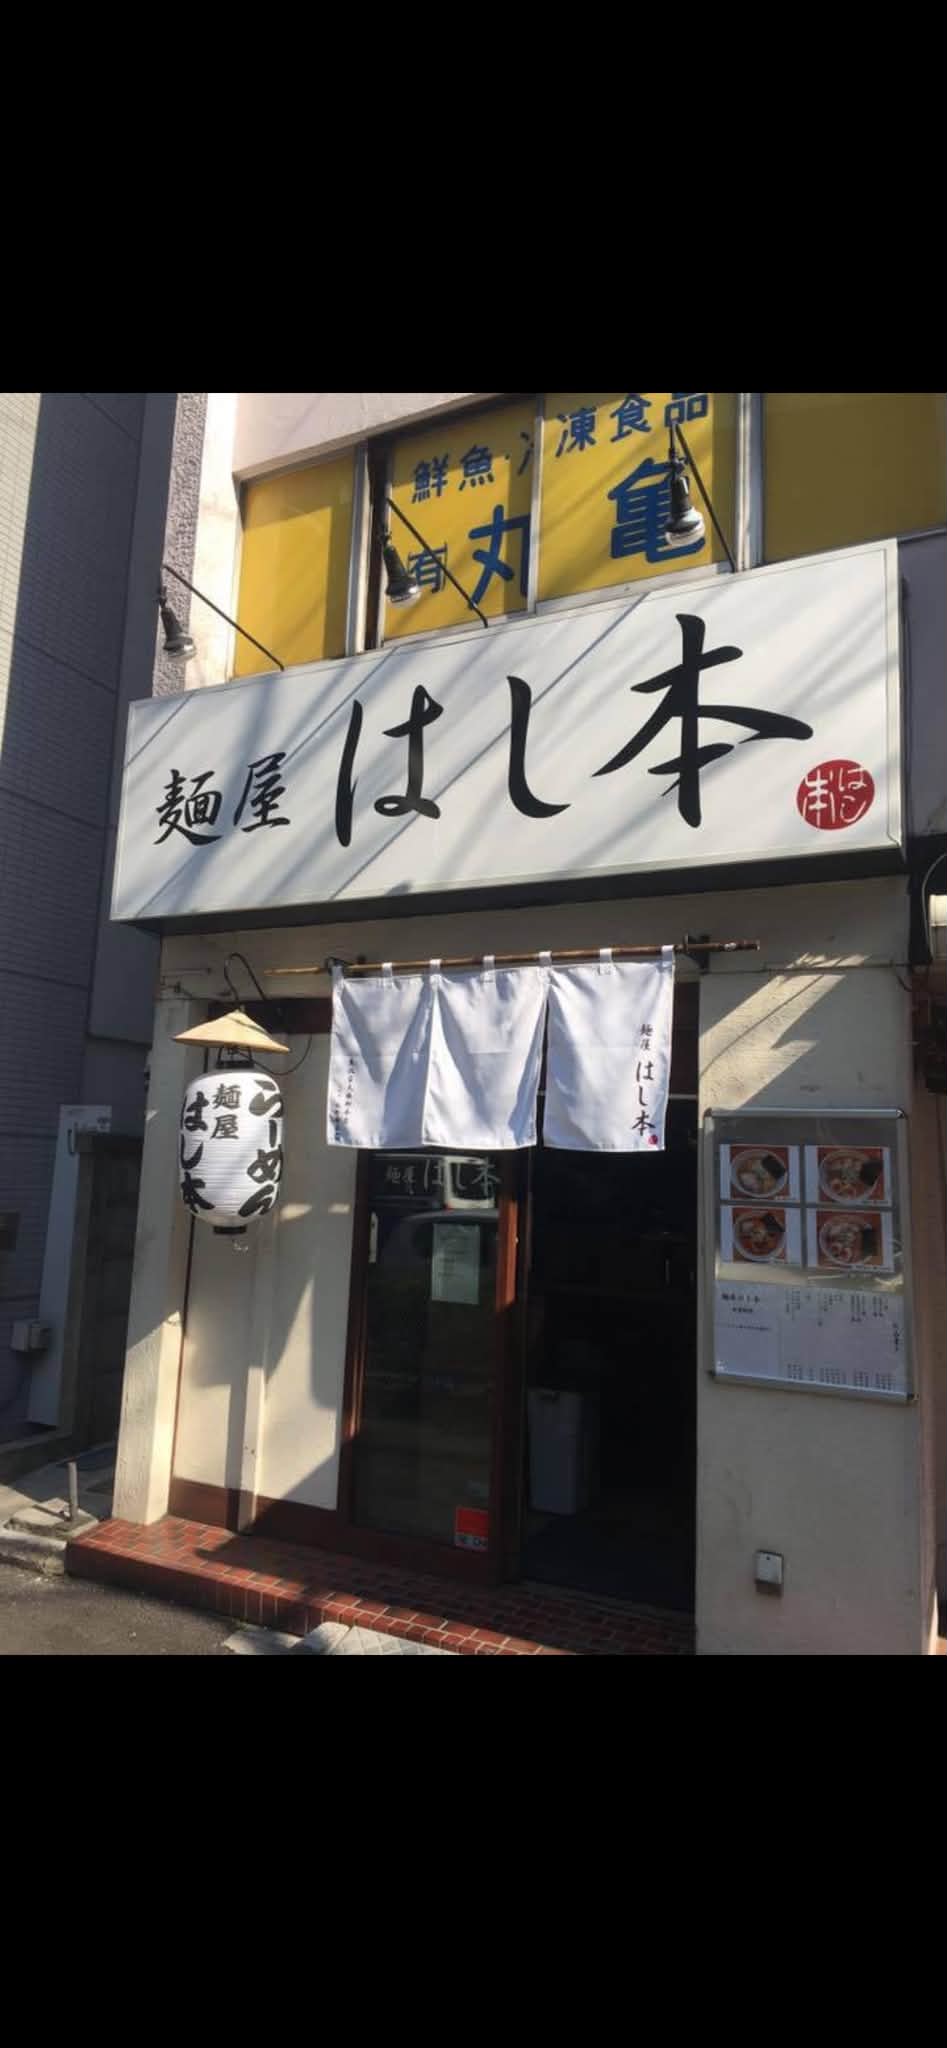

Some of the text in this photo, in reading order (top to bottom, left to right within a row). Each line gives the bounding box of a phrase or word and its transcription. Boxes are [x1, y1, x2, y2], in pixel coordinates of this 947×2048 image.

[153, 613, 814, 848] 麺屋 はし本
[181, 1091, 215, 1214] はし本
[210, 1084, 242, 1140] 麺屋
[238, 1079, 284, 1218] らーめん
[632, 1061, 656, 1136] はし本
